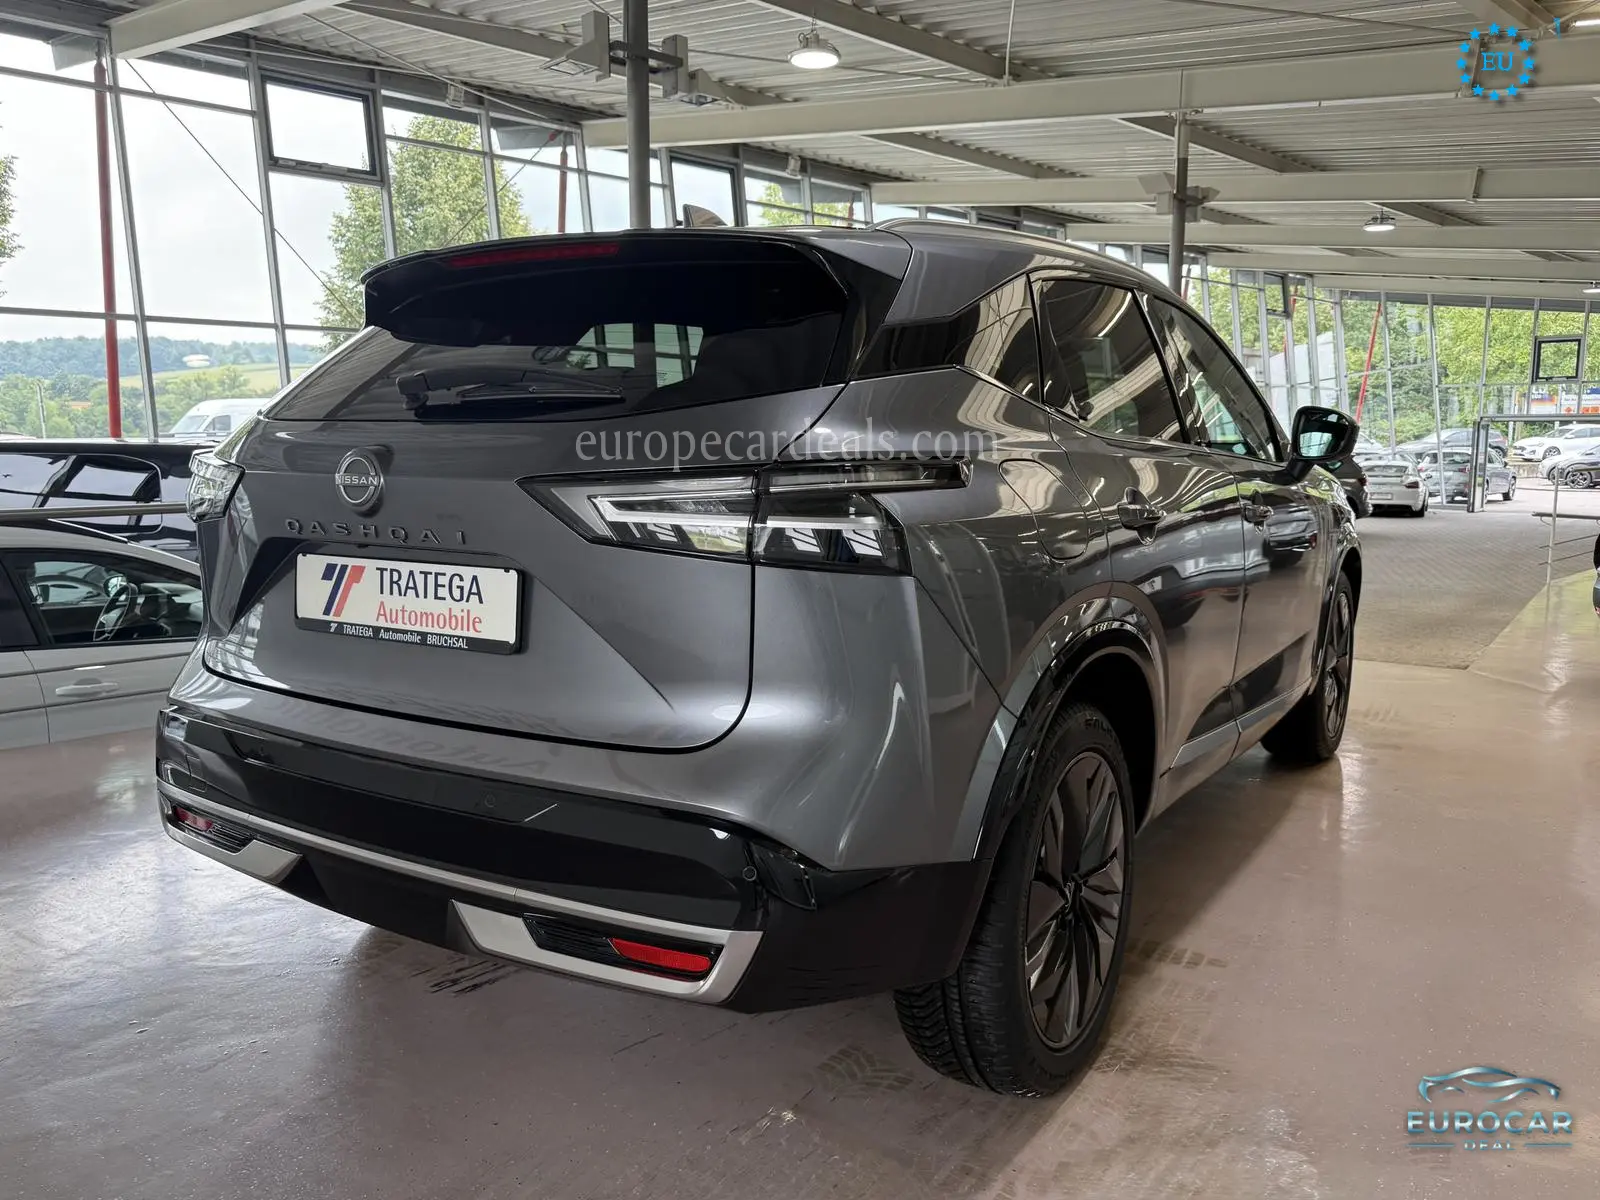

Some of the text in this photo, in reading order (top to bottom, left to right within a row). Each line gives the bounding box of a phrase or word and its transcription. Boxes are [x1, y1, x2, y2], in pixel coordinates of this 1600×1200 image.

[335, 473, 379, 486] NISSAN
[285, 518, 466, 545] QASHQAI
[375, 566, 484, 605] TRATEGA
[375, 600, 483, 633] Automobile
[342, 624, 468, 649] TRATEGA Automobile BRUCHSAL
